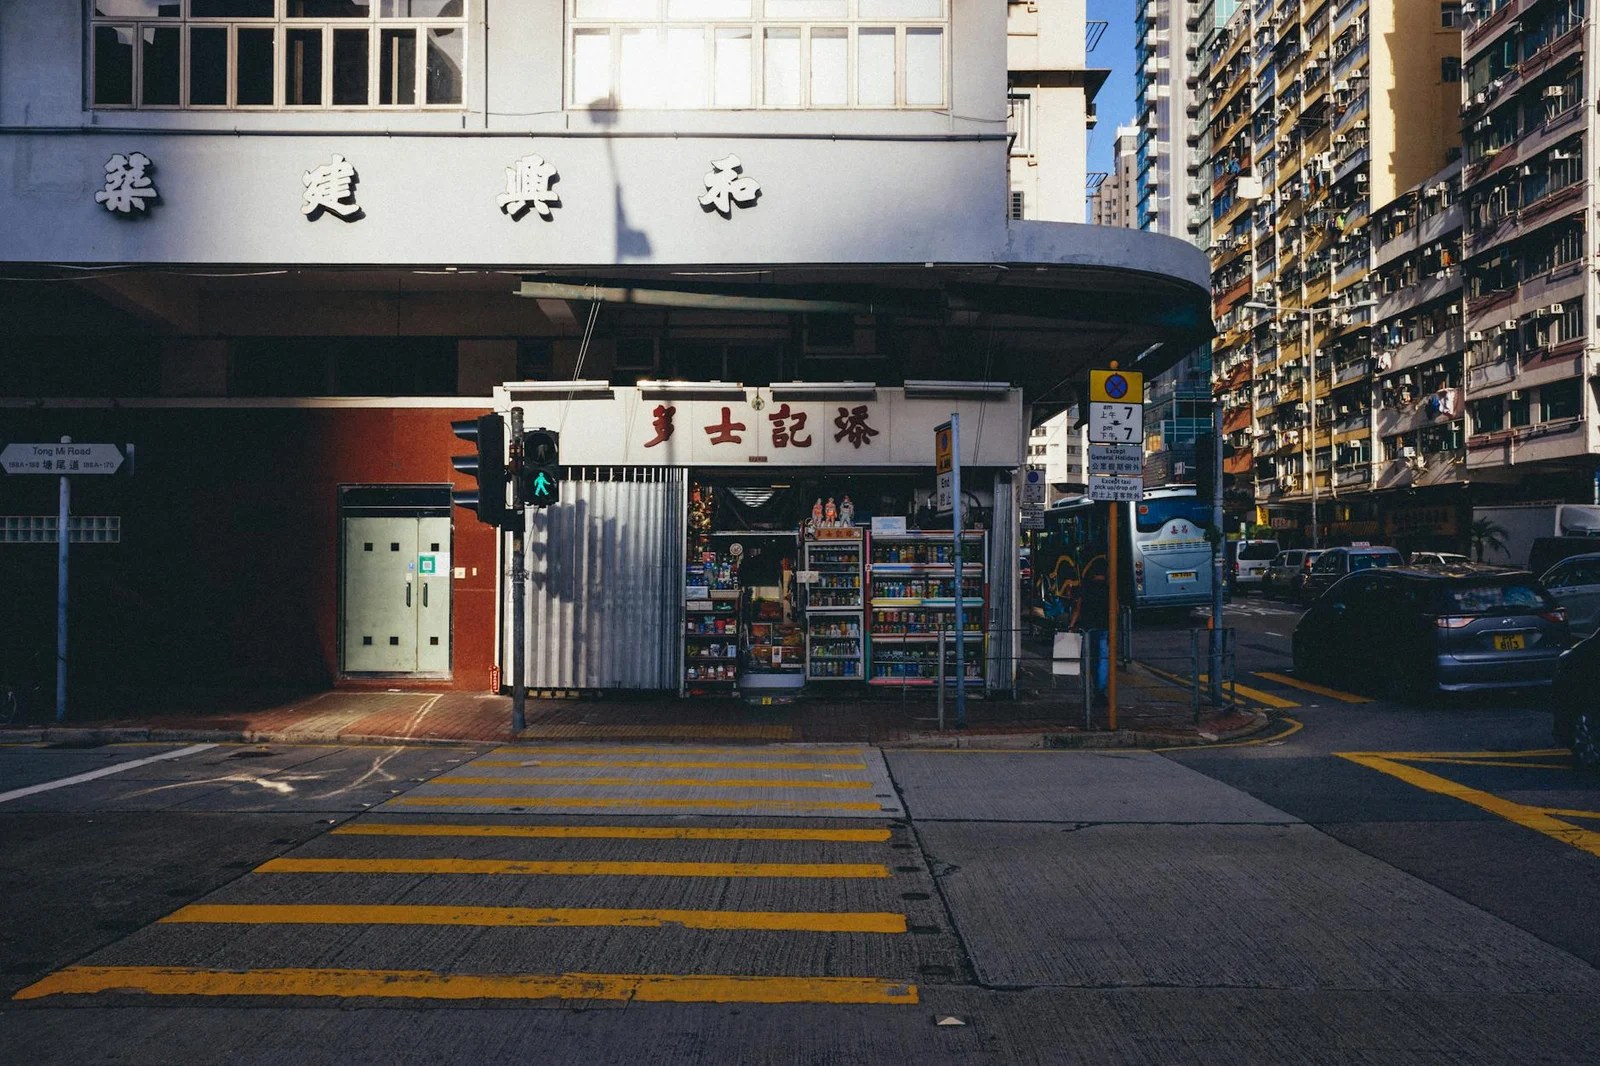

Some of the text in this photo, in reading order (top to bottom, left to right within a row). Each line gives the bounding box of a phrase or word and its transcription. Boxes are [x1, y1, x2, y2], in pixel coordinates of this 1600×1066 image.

[1100, 411, 1116, 419] 上午
[1124, 407, 1133, 419] 7
[1100, 432, 1116, 440] 下午
[1124, 427, 1133, 440] 7
[32, 447, 91, 456] Tong Mi Road
[43, 460, 79, 470] 塘尾道
[941, 476, 949, 488] End
